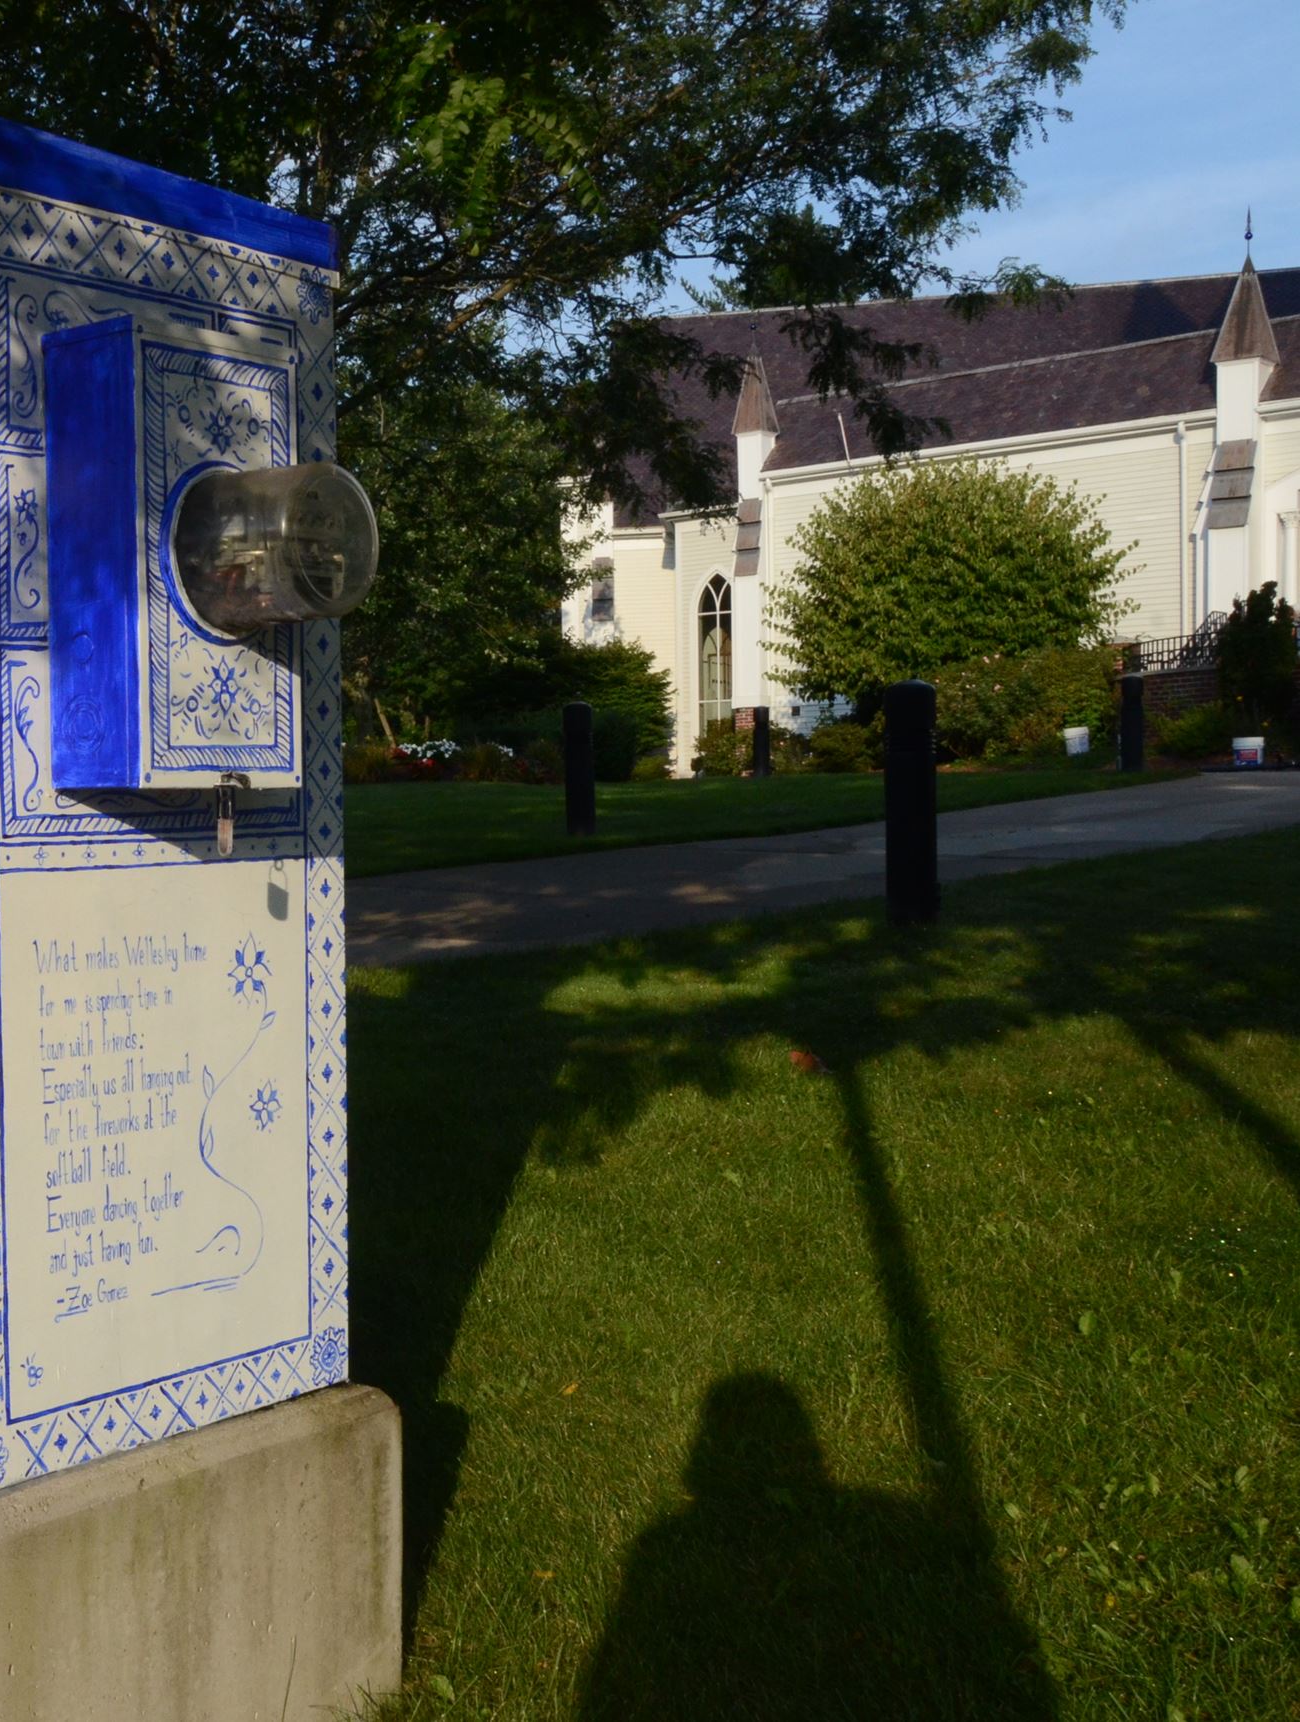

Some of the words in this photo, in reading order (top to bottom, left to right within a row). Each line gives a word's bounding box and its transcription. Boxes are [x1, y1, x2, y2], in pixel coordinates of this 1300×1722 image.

[32, 940, 78, 973] What
[86, 937, 120, 969] makes
[124, 935, 178, 972] Wellesley
[183, 932, 207, 963] home
[39, 984, 54, 1016] for
[64, 997, 76, 1014] me
[85, 995, 93, 1013] is
[96, 978, 133, 1017] spending
[137, 978, 158, 1010] time
[164, 986, 173, 1005] in
[40, 1027, 65, 1060] town
[69, 1021, 93, 1057] with
[41, 1064, 99, 1112] Especially
[103, 1077, 116, 1095] us
[121, 1058, 134, 1092] all
[140, 1057, 174, 1097] hanging
[177, 1052, 191, 1085] out
[44, 1112, 60, 1145] for
[68, 1107, 88, 1142] the
[95, 1100, 140, 1137] fireworks
[144, 1098, 153, 1129] at
[161, 1094, 177, 1128] the
[46, 1147, 91, 1189] softball
[101, 1142, 131, 1178] field.
[46, 1195, 96, 1236] Everyone
[103, 1184, 138, 1224] dancing
[143, 1172, 184, 1221] together
[50, 1238, 68, 1274] and
[73, 1233, 94, 1277] just
[100, 1229, 131, 1266] having
[138, 1221, 158, 1255] fun.
